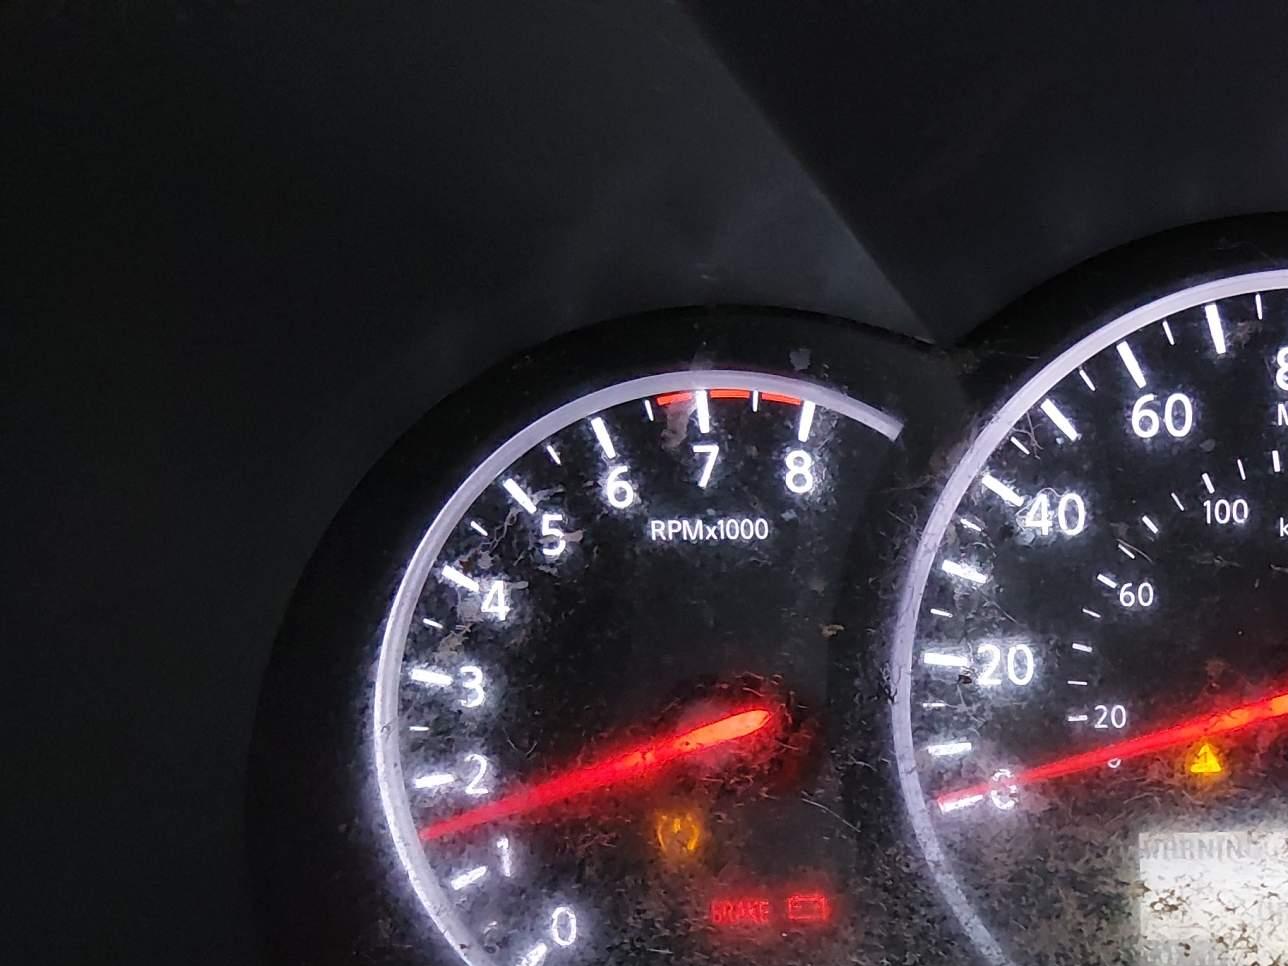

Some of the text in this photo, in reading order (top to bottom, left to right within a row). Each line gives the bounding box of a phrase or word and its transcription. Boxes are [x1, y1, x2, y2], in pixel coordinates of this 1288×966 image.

[1131, 393, 1193, 438] 60
[606, 464, 636, 509] 6
[693, 444, 719, 489] 7
[784, 449, 814, 494] 8
[650, 517, 769, 541] RPMx1000
[1024, 492, 1086, 537] 40
[1202, 498, 1249, 525] 100
[540, 513, 567, 557] 5
[480, 579, 512, 621] 4
[1119, 582, 1154, 608] 60
[977, 643, 1034, 687] 20
[460, 665, 485, 708] 3
[1093, 704, 1127, 729] 20
[464, 753, 489, 794] 2
[551, 906, 576, 946] 0
[711, 901, 769, 923] BRAKE
